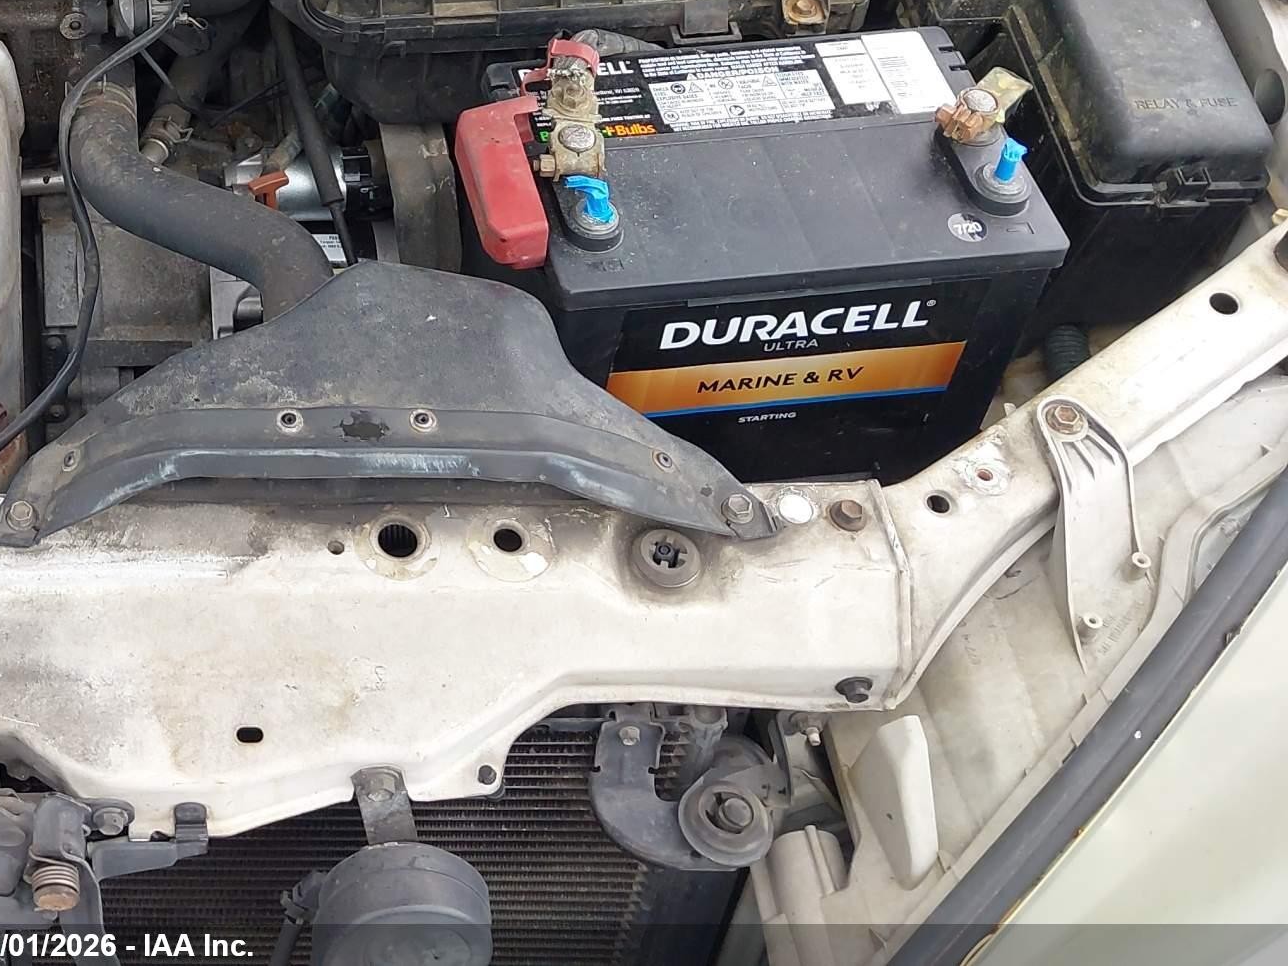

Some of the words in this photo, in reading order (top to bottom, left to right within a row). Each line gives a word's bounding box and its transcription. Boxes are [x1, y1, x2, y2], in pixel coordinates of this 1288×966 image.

[1134, 98, 1181, 109] RELAY
[1199, 97, 1239, 107] FUSE
[763, 338, 819, 352] ULTRA
[697, 372, 797, 394] MARINE
[803, 371, 820, 384] &
[828, 365, 865, 382] RV
[738, 411, 797, 424] STARTING
